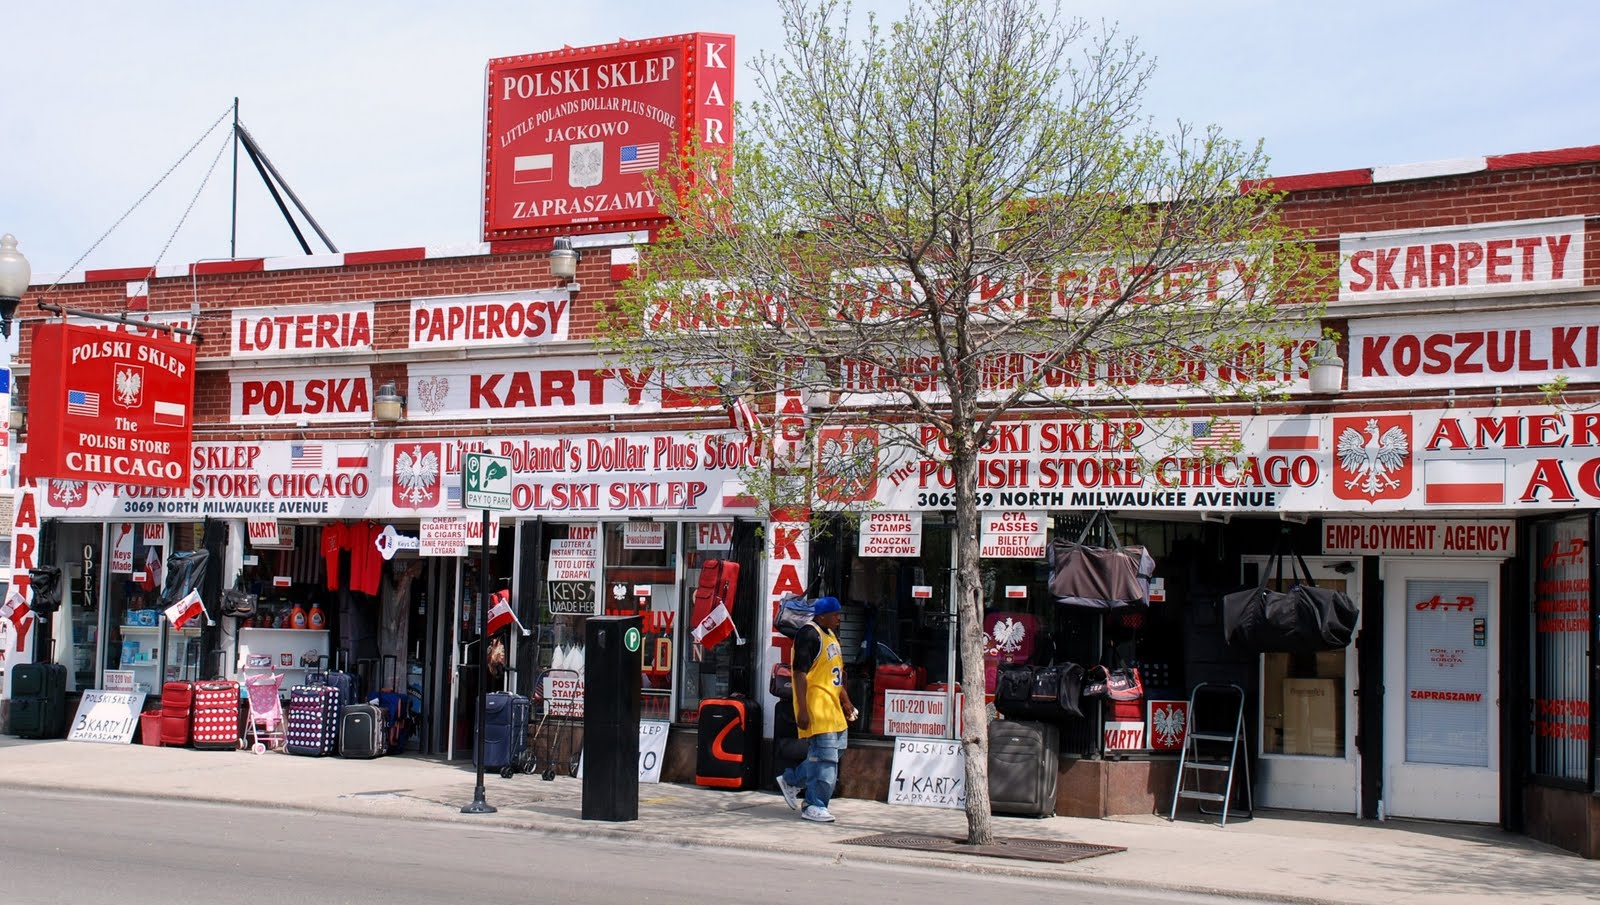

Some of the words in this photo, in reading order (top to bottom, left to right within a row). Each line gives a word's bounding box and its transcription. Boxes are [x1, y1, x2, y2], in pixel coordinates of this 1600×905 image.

[503, 67, 590, 101] POLSKI
[597, 56, 675, 90] SKLEP
[501, 117, 534, 148] LITTLE
[536, 100, 579, 126] POLANDS
[580, 98, 619, 112] DOLLAR
[621, 99, 645, 115] PLUS
[646, 105, 676, 129] STORE
[545, 121, 630, 143] JACKOWO
[512, 190, 657, 219] ZAPRASZAMY
[1350, 234, 1572, 292] SKARPETY
[1057, 259, 1257, 308] GAZETY
[414, 299, 569, 341] PAPIEROSY
[239, 311, 369, 352] LOTERIA
[71, 341, 131, 364] POLSKI
[137, 343, 186, 379] SKLEP
[1362, 326, 1600, 377] KOSZULKI
[242, 377, 369, 416] POLSKA
[469, 367, 655, 409] KARTY
[115, 416, 138, 431] The
[79, 432, 126, 451] POLISH
[129, 437, 170, 455] STORE
[920, 424, 1030, 454] POSKI
[1039, 421, 1144, 454] SKLEP
[193, 445, 261, 470] SKLEP
[500, 438, 581, 472] Poland's
[587, 438, 648, 471] Dollar
[654, 436, 697, 470] Plus
[65, 452, 183, 479] CHICAGO
[918, 459, 1030, 490] POISH
[1039, 457, 1144, 489] STORE
[1157, 455, 1319, 488] CHICAGO
[887, 462, 917, 488] The
[192, 473, 261, 499] STORE
[267, 473, 369, 499] CHICAGO
[469, 494, 482, 503] PAY
[484, 496, 491, 504] TO
[493, 496, 509, 506] PARK
[512, 481, 599, 511] OLSKI
[608, 481, 707, 510] SKLEP
[1000, 492, 1063, 507] NORTH
[1070, 492, 1186, 507] MILWAUKEE
[1193, 491, 1275, 507] AVENUE
[124, 501, 154, 513] 3069
[157, 501, 200, 513] NORTH
[204, 501, 275, 513] MILWAUKEE
[278, 500, 328, 513] AVENUE
[871, 513, 912, 523] POSTAL
[1002, 512, 1027, 522] CTA
[249, 522, 277, 538] KARTY
[570, 527, 598, 540] KART
[699, 522, 734, 544] FAX
[869, 523, 912, 532] STAMPS
[990, 522, 1039, 532] PASSES
[869, 537, 911, 545] ZNACZKI
[997, 535, 1030, 545] BILETY
[1326, 525, 1436, 549] EMPLOYMENT
[1444, 525, 1510, 551] AGENCY
[114, 550, 132, 560] Keys
[864, 546, 916, 554] POCZTOWE
[982, 546, 1045, 557] AUTOBUSOWE
[112, 561, 132, 571] Made
[554, 560, 571, 569] TOTO
[573, 560, 595, 569] LOTEK
[83, 544, 93, 607] OPEN
[561, 570, 590, 579] ZDRAPKI
[552, 582, 586, 601] KEYS
[552, 601, 577, 612] MADE
[579, 602, 595, 612] HER
[629, 631, 637, 648] P
[1411, 690, 1482, 702] ZAPRASZAMY
[890, 699, 924, 714] 110-220
[928, 700, 944, 715] Volt
[76, 714, 87, 731] 3
[888, 719, 946, 735] Transformator
[74, 732, 122, 740] ZAPRASZAMY
[1104, 730, 1141, 749] KARTY
[900, 743, 942, 755] POLSKI
[895, 770, 905, 791] 4
[911, 776, 960, 794] KARTY
[896, 793, 966, 806] ZAPRASZAM
